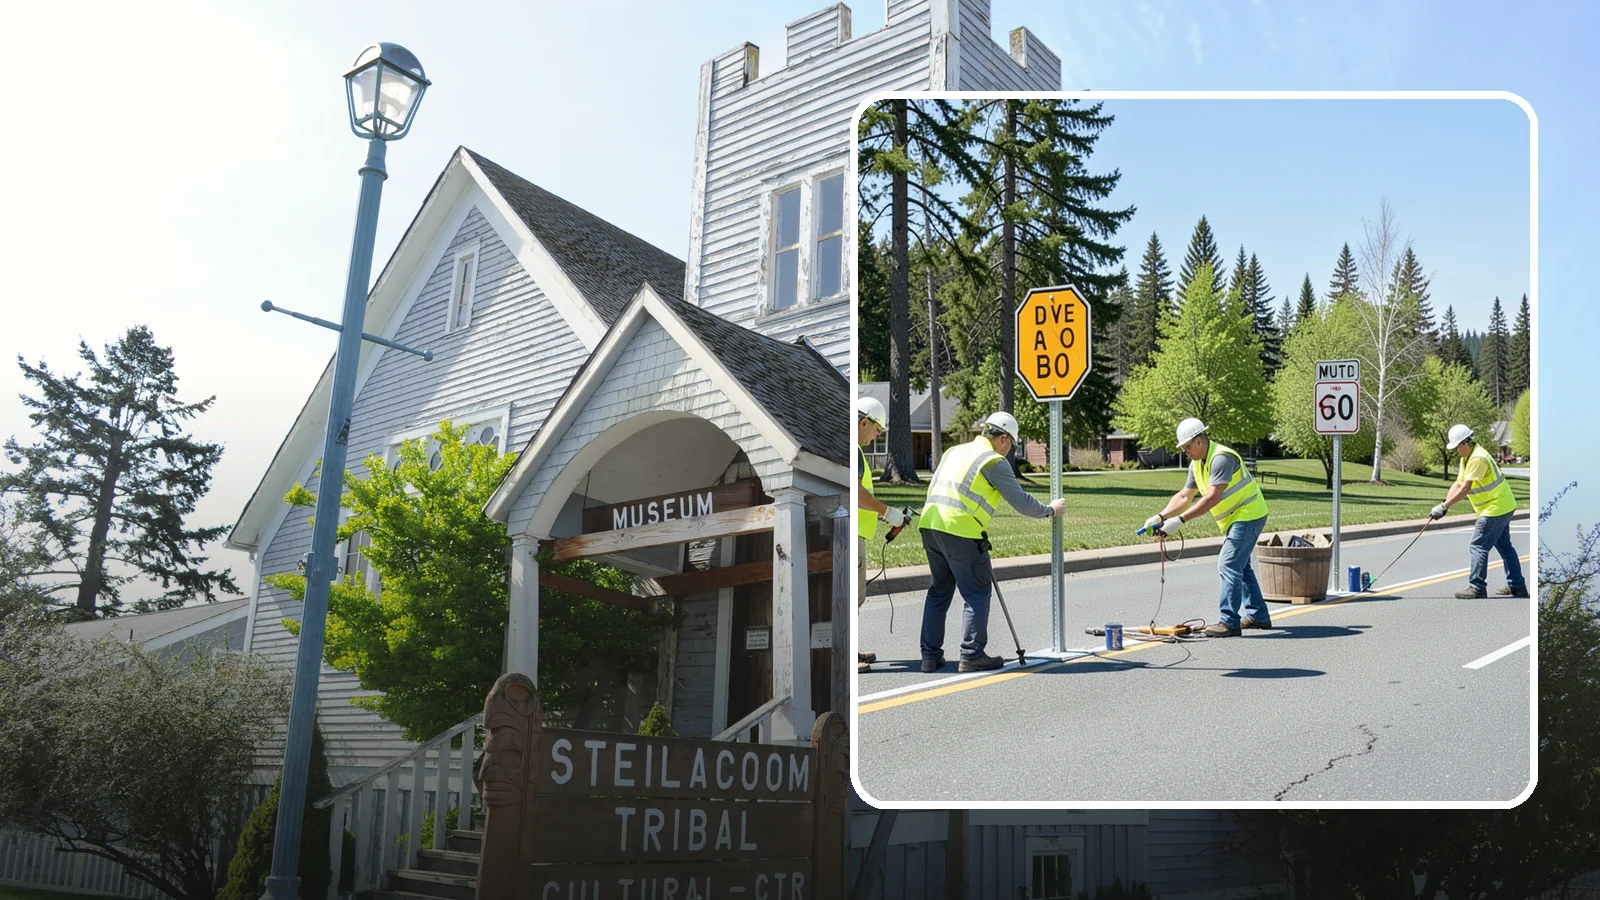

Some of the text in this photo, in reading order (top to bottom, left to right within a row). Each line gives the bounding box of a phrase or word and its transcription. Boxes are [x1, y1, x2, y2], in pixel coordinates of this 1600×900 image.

[1035, 303, 1075, 325] DVE
[1034, 330, 1047, 351] A
[1037, 352, 1070, 379] BO
[1318, 394, 1354, 421] 60
[613, 491, 714, 531] MUSEUM
[550, 738, 810, 793] STEILACOOM
[615, 806, 758, 852] TRIBAL
